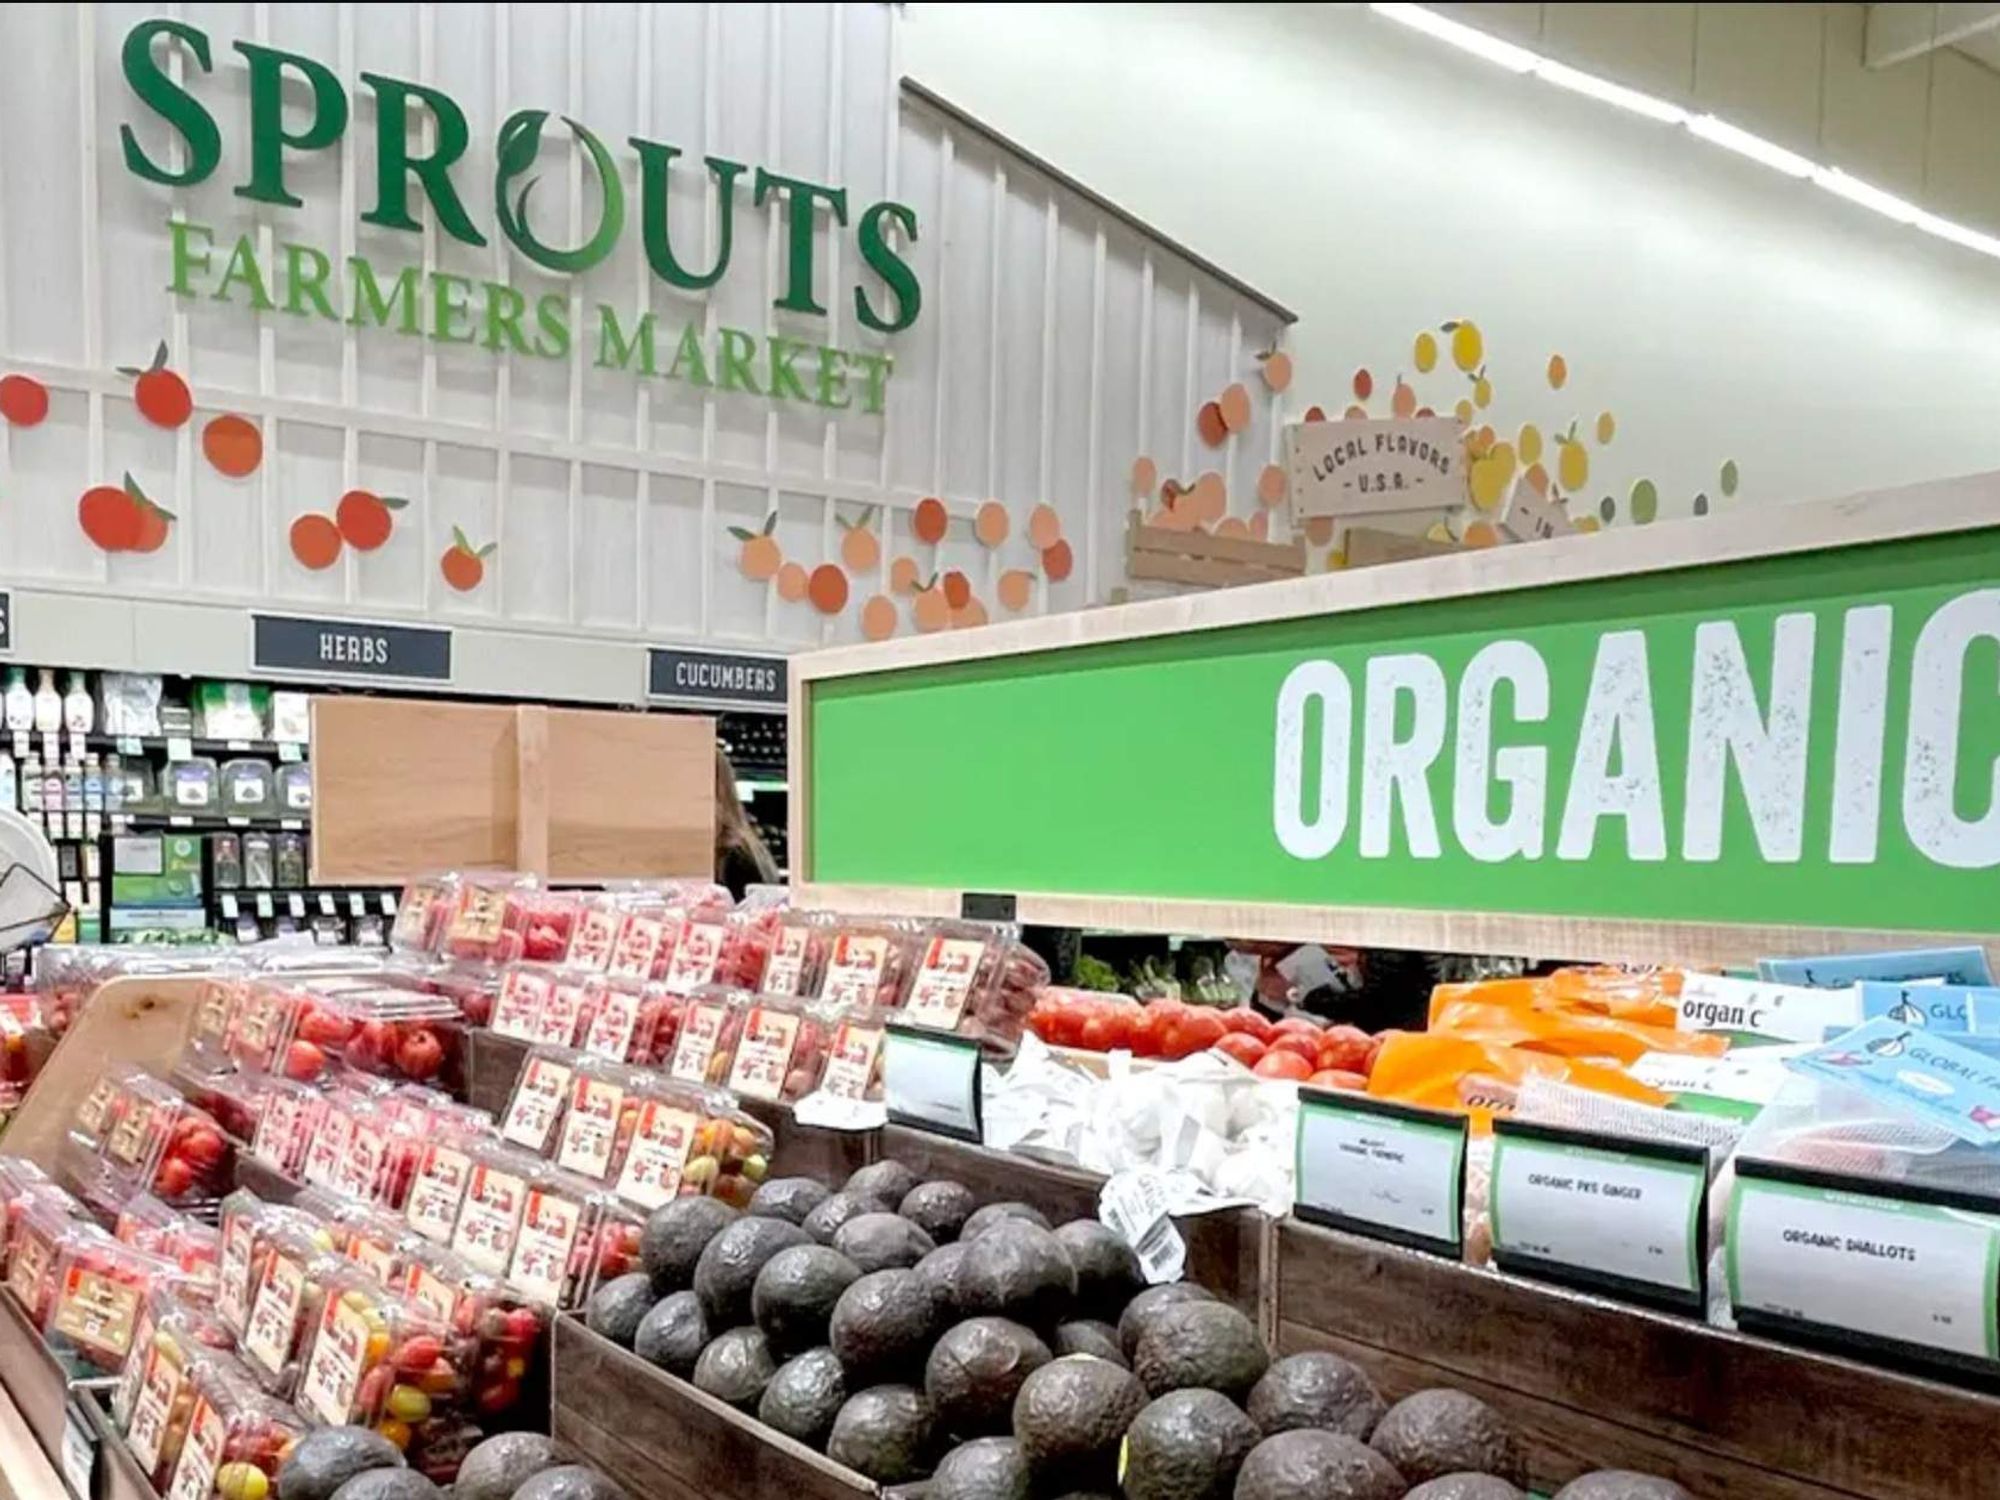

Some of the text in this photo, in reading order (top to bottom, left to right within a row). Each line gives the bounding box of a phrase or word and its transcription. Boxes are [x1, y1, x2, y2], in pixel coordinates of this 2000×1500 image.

[120, 19, 922, 333] SPROUTS
[166, 220, 893, 414] FARMERS MARKET
[1313, 433, 1449, 482] LOCAL FLAVORS
[319, 633, 389, 664] HERBS
[675, 661, 777, 692] CUCUMBERS
[1273, 587, 2000, 869] ORGANIC
[1528, 1173, 1574, 1192] ORGANIC
[1602, 1183, 1643, 1200] GINGER
[1783, 1228, 1842, 1251] ORGANIC
